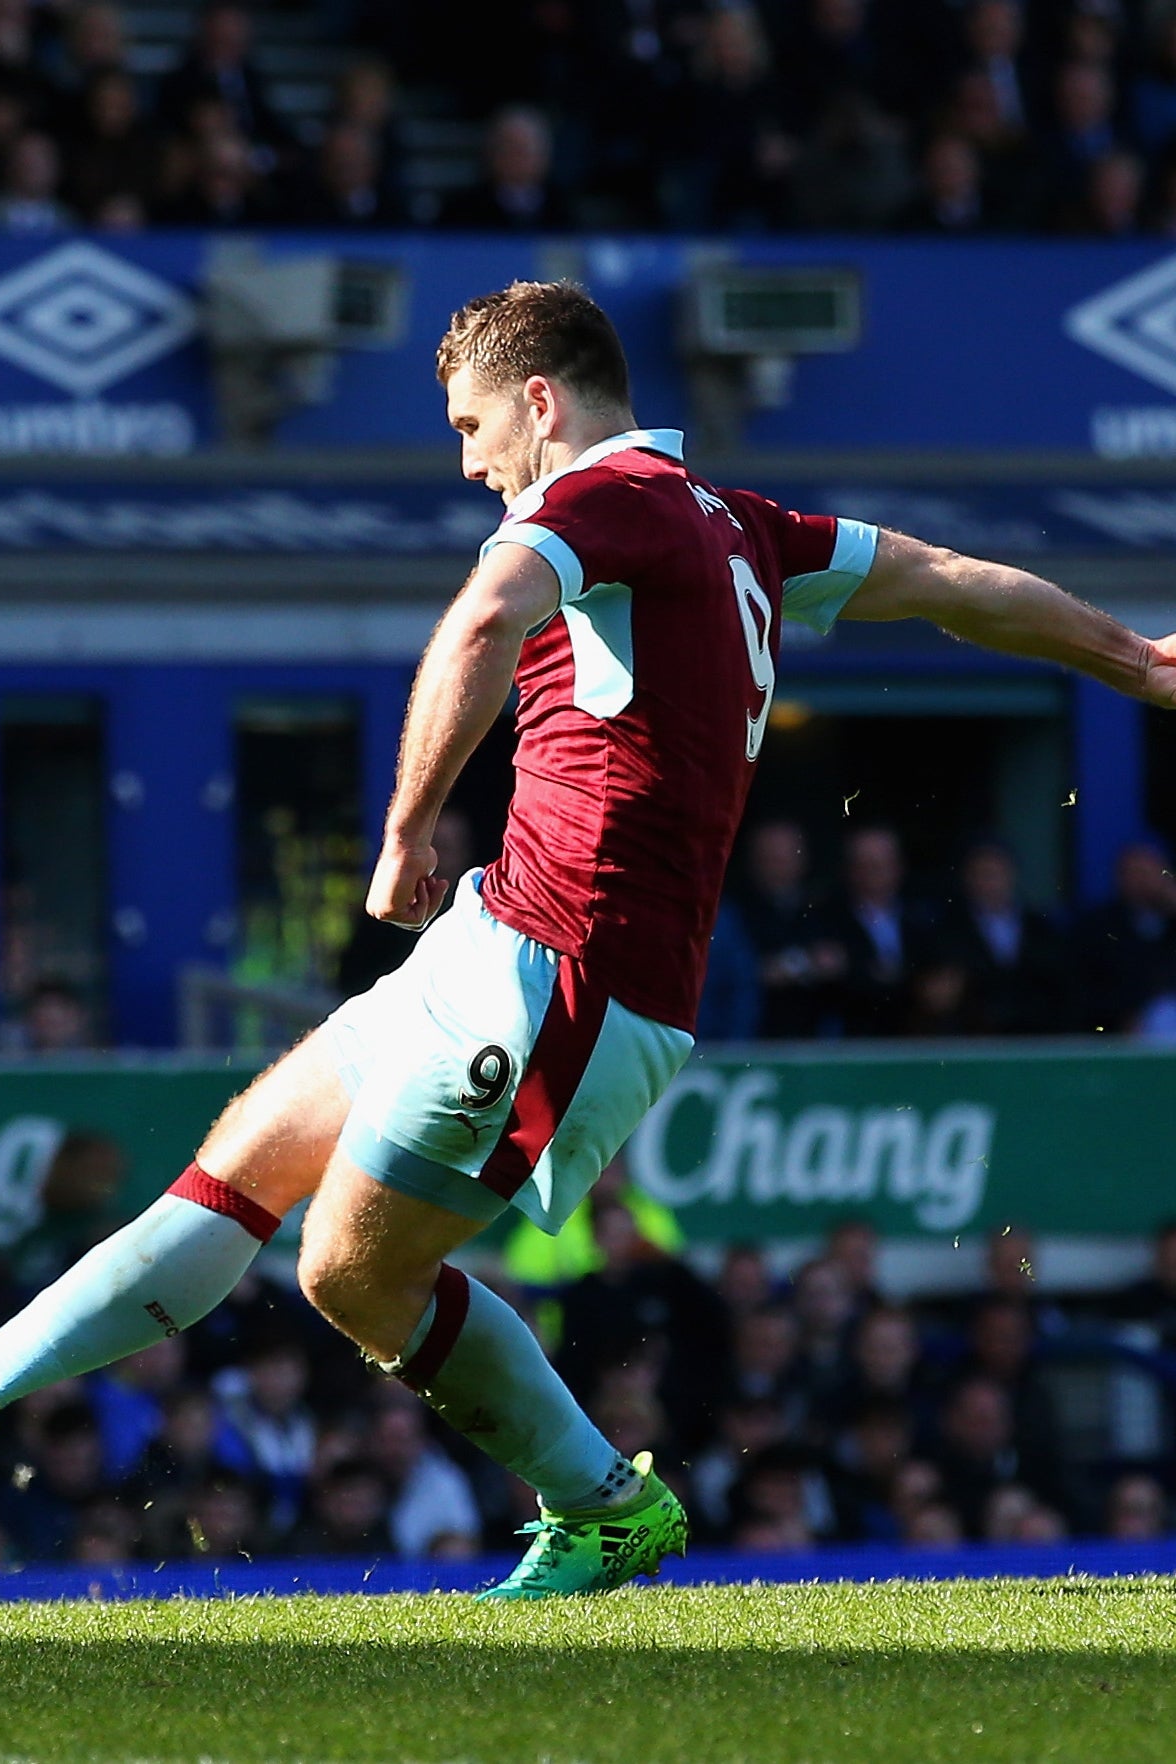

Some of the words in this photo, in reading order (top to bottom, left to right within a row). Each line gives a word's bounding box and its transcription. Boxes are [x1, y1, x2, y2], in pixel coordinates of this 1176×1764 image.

[727, 554, 776, 763] 9
[458, 1042, 512, 1110] 9
[627, 1067, 998, 1231] Chang
[143, 1300, 179, 1338] BFC
[605, 1524, 650, 1583] adidas
